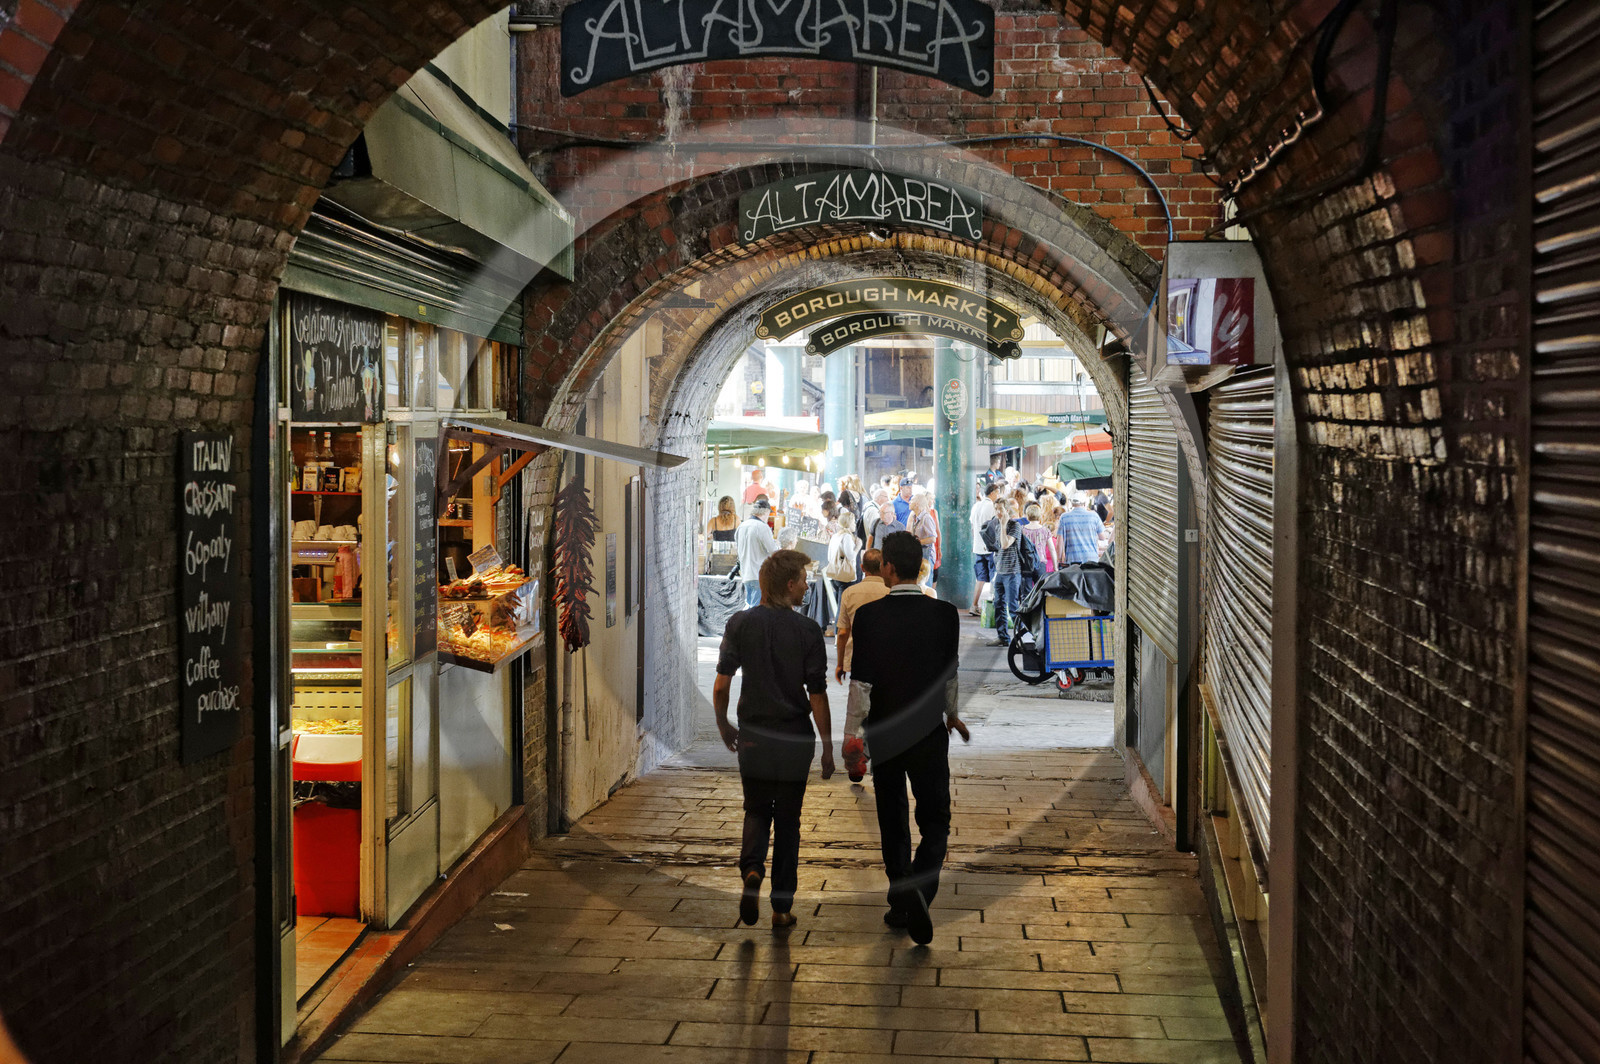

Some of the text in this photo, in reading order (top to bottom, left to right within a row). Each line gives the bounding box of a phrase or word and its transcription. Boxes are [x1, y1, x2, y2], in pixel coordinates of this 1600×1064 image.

[774, 287, 1007, 329] BOROUGH MARKET
[820, 315, 921, 347] BOROUGH
[1047, 414, 1070, 425] orough
[192, 435, 234, 473] ITALIAN
[210, 523, 232, 574] only
[185, 590, 231, 645] with any
[198, 680, 241, 724] purchase
